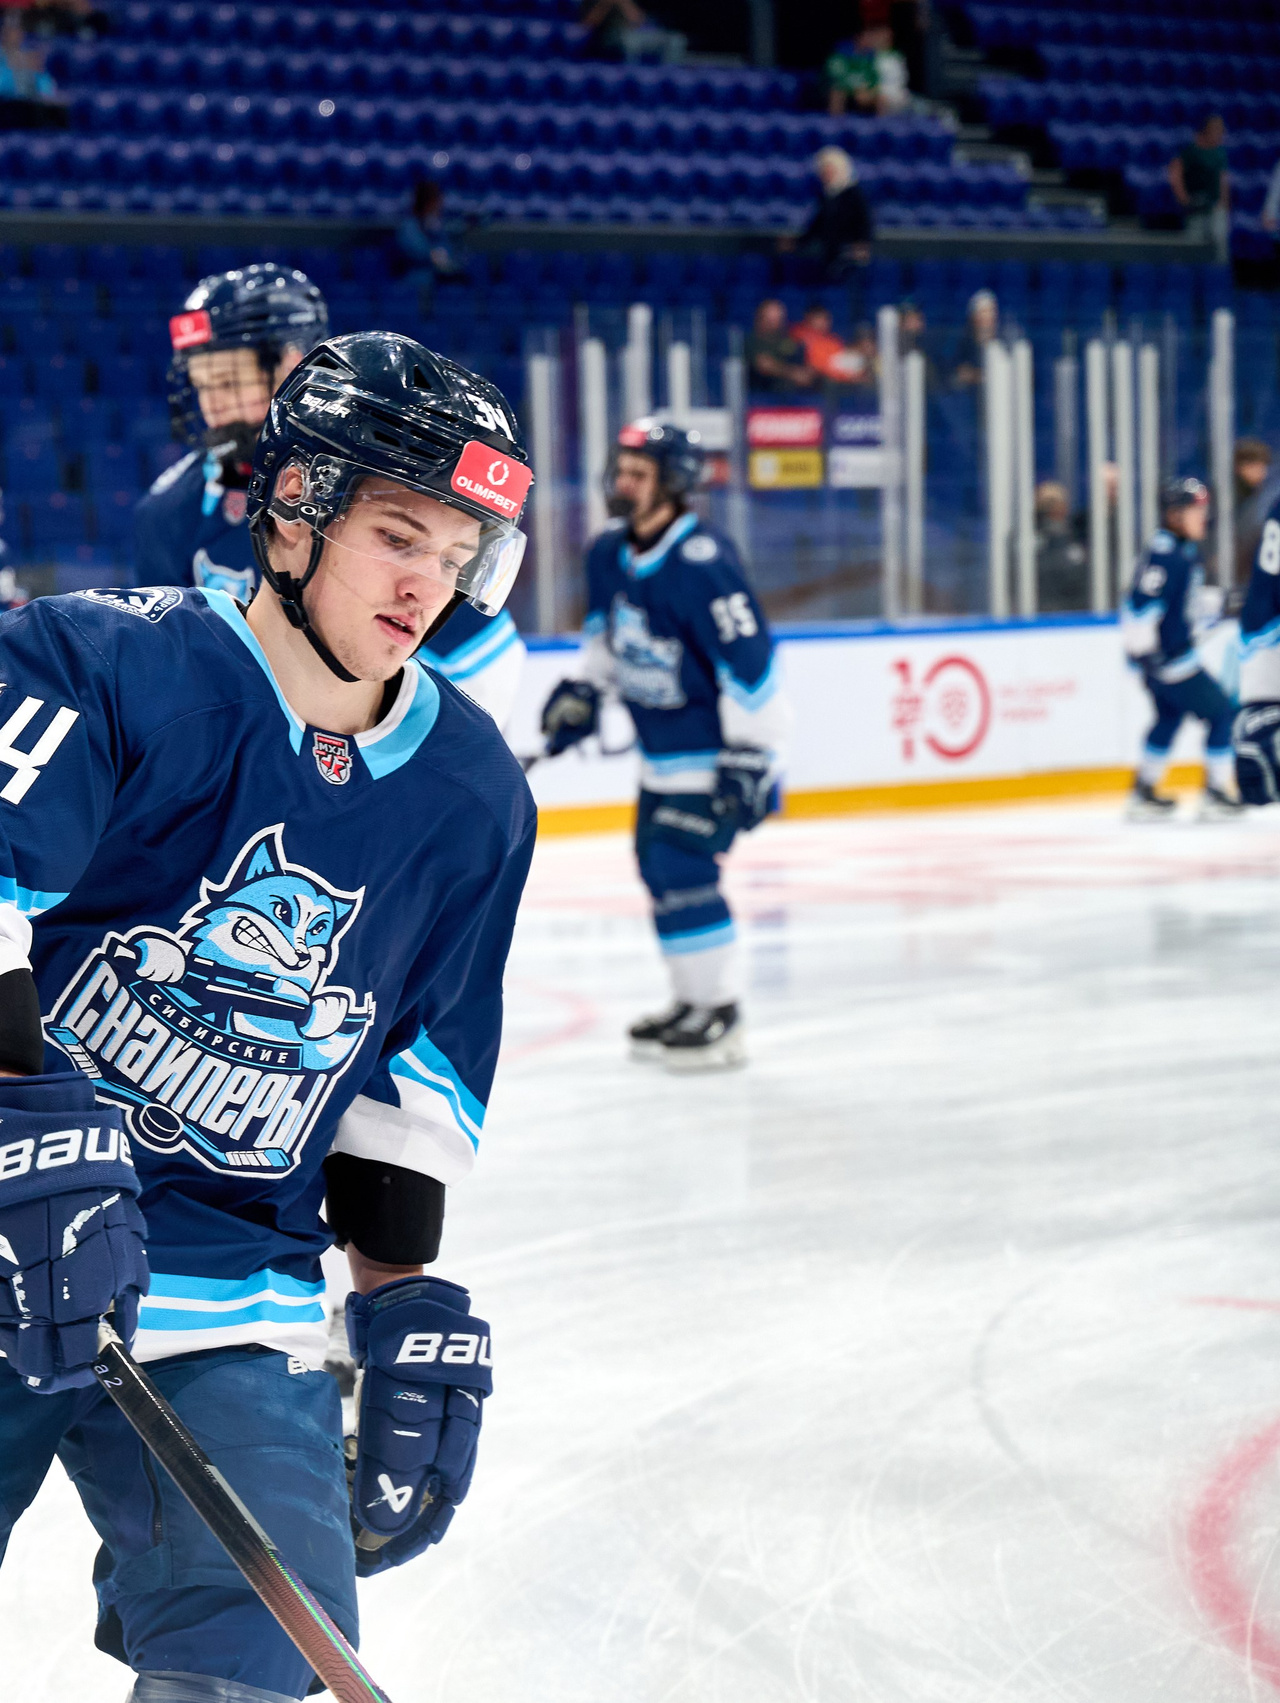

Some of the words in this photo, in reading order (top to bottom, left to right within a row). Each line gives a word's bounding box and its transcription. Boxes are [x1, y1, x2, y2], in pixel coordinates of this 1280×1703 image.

[465, 392, 515, 443] 34
[456, 475, 518, 513] OLIMPBET
[318, 742, 347, 757] МХЛ
[148, 993, 289, 1064] СИБИРСКИЕ
